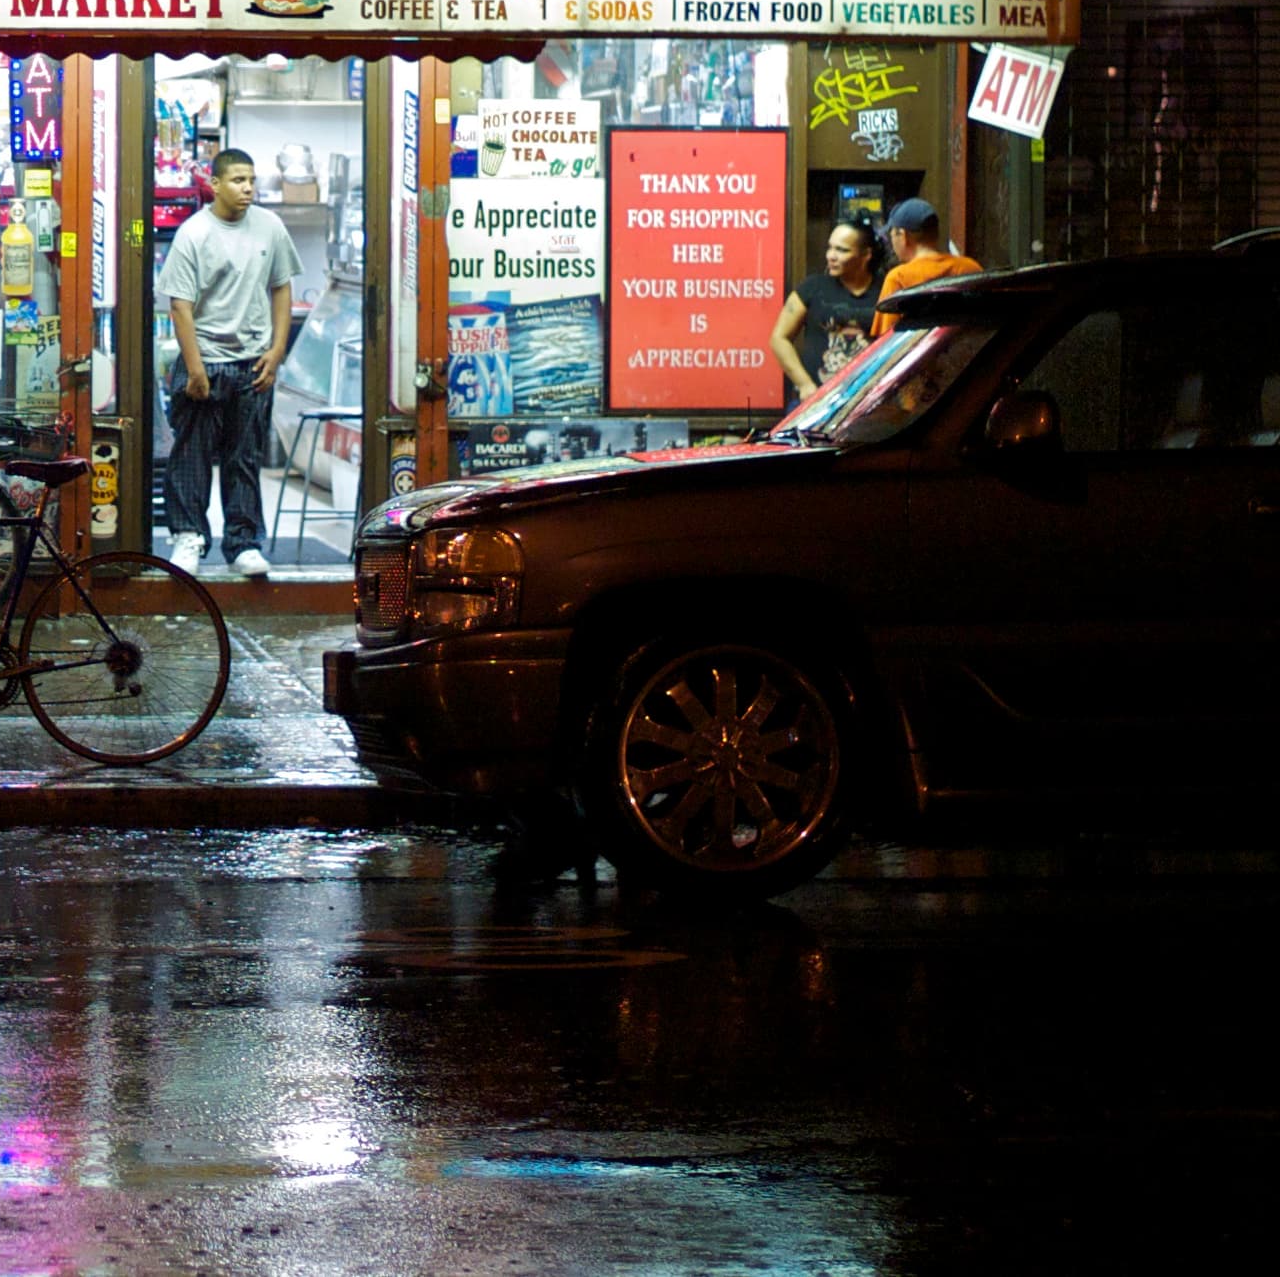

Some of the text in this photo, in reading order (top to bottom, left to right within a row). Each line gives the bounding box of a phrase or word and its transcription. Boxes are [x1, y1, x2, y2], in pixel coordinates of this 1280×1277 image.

[360, 0, 508, 21] COFFEE & TEA
[565, 0, 653, 21] & SODAS
[683, 1, 823, 22] FROZEN FOOD
[842, 2, 975, 25] VEGETABLES
[998, 5, 1047, 27] MEA
[975, 55, 1058, 127] ATM
[26, 53, 55, 152] ATM
[483, 112, 509, 130] HOT
[512, 110, 577, 125] COFFEE
[860, 112, 897, 131] RICKS
[403, 91, 418, 190] BUD LIGHT
[512, 129, 598, 145] CHOCOLATE
[512, 147, 548, 162] TEA
[571, 155, 597, 178] go
[639, 173, 757, 194] THANK YOU
[451, 199, 597, 237] e Appreciate
[626, 209, 769, 229] FOR SHOPPING
[91, 200, 105, 299] BUD LIGHT
[672, 243, 724, 263] HERE
[448, 248, 596, 279] our Business
[622, 278, 775, 299] YOUR BUSINESS
[689, 313, 708, 334] IS
[448, 327, 489, 342] LUSH
[448, 341, 488, 354] UPPiE
[627, 348, 765, 369] APPRECIATED
[475, 443, 527, 455] BACARDI
